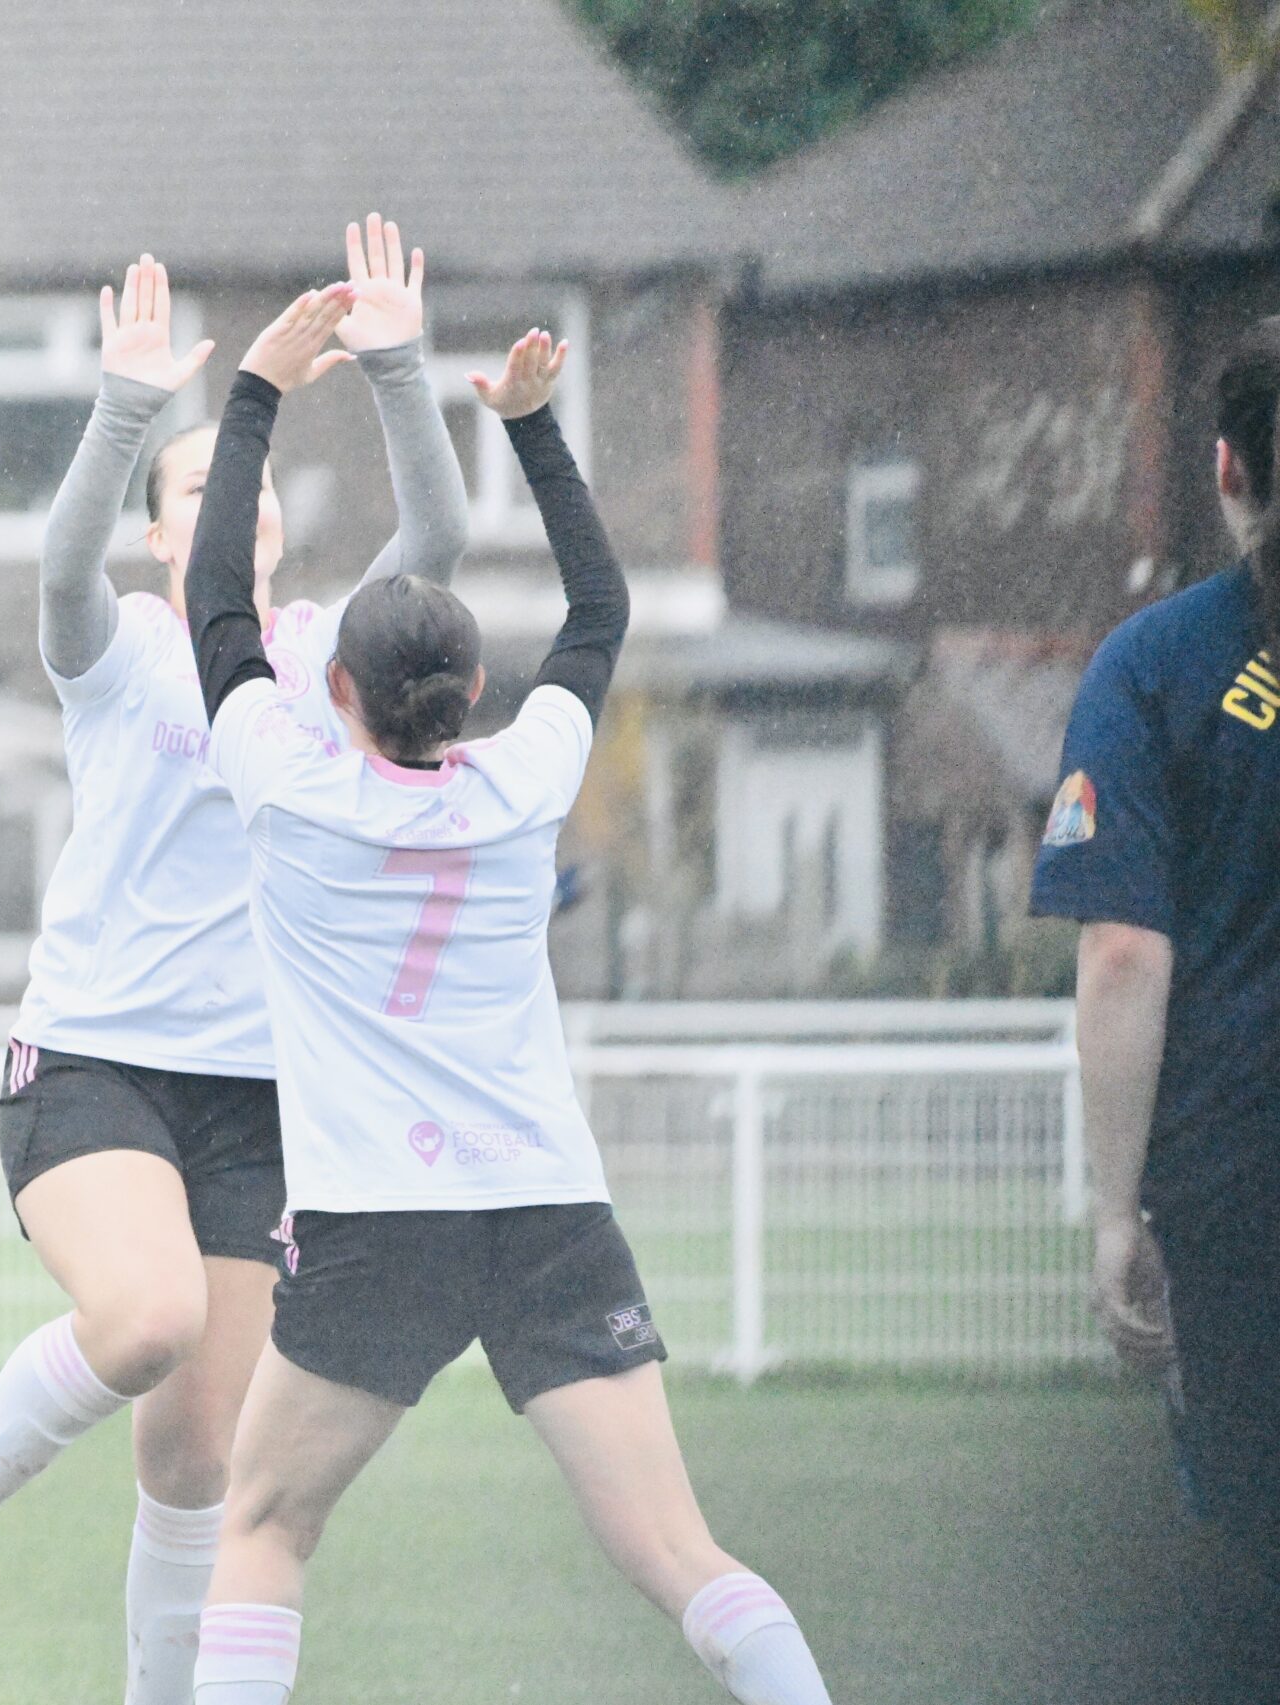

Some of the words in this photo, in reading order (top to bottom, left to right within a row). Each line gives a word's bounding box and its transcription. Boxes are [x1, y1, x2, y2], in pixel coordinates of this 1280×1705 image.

[371, 847, 476, 1021] 7
[452, 1130, 544, 1148] FOOTBALL
[455, 1147, 521, 1166] GROUP
